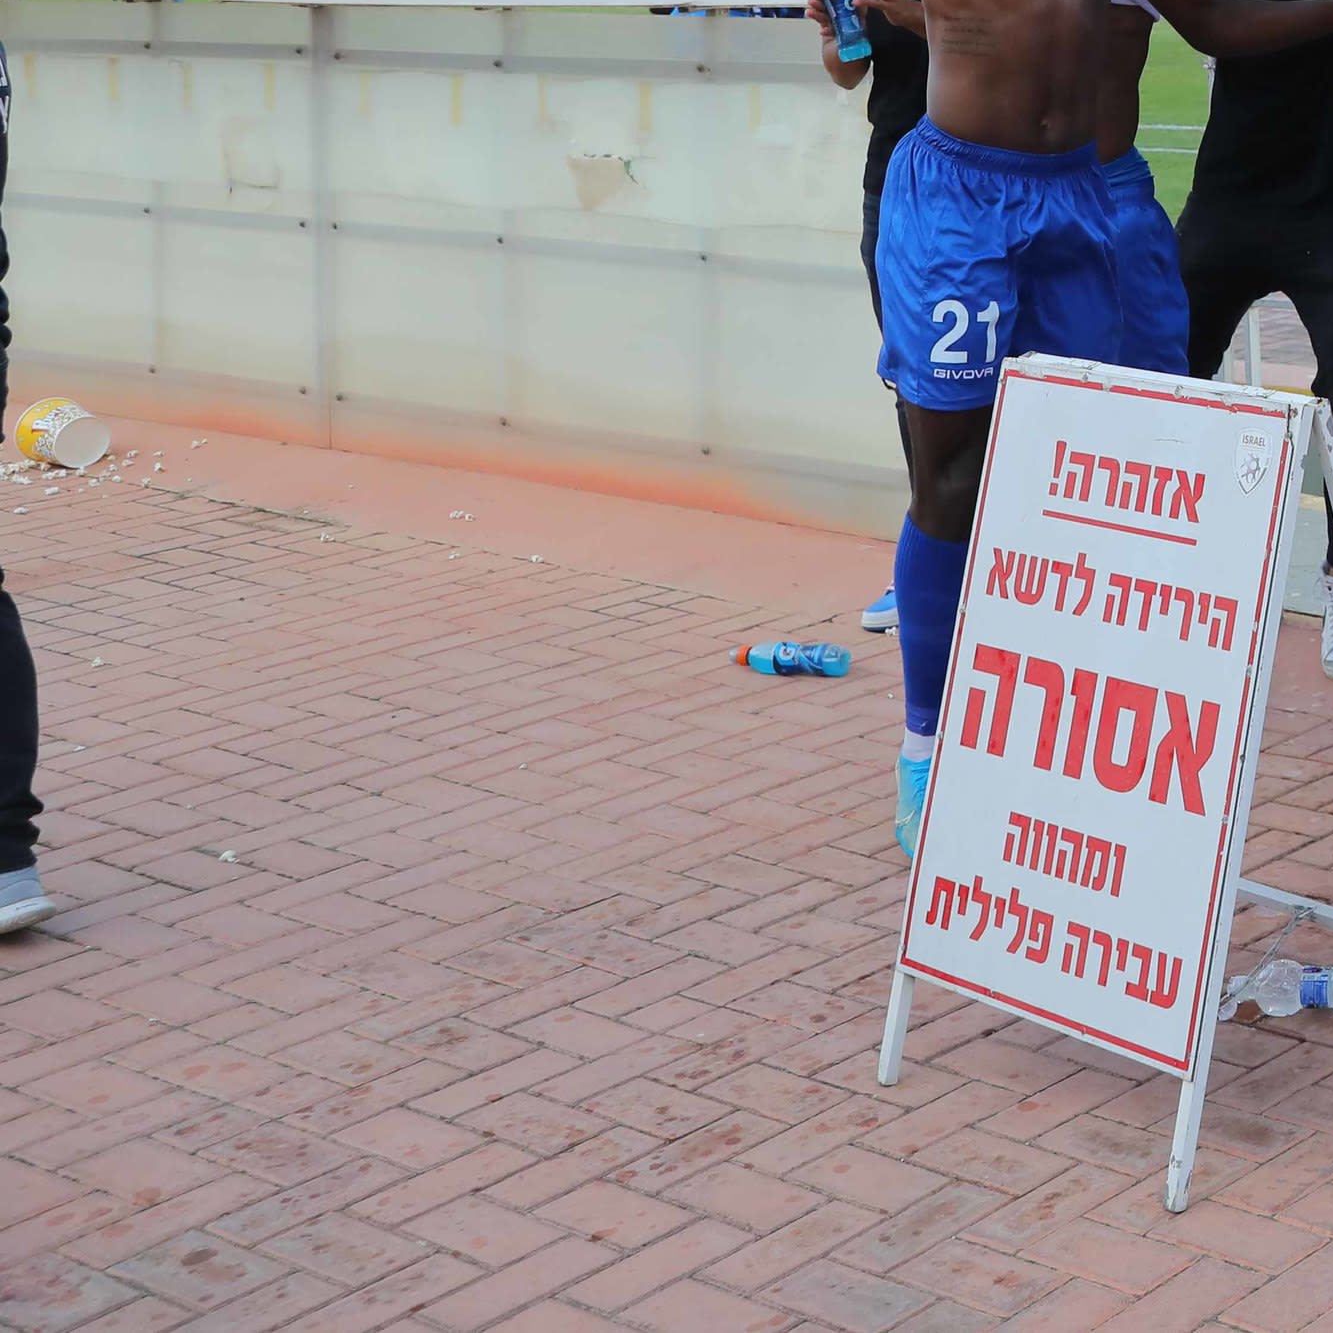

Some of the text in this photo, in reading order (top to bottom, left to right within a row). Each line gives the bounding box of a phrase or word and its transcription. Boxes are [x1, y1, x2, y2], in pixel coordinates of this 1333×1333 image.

[930, 299, 1000, 363] 21
[933, 367, 994, 379] GIVOVA
[1049, 441, 1206, 523] אזהרה!
[1242, 434, 1266, 447] ISRAEL
[986, 547, 1238, 651] הירידה לדשא
[960, 643, 1220, 816] אסורה
[1003, 812, 1127, 898] ומהווה
[925, 875, 1183, 1010] עבירה פלילית
